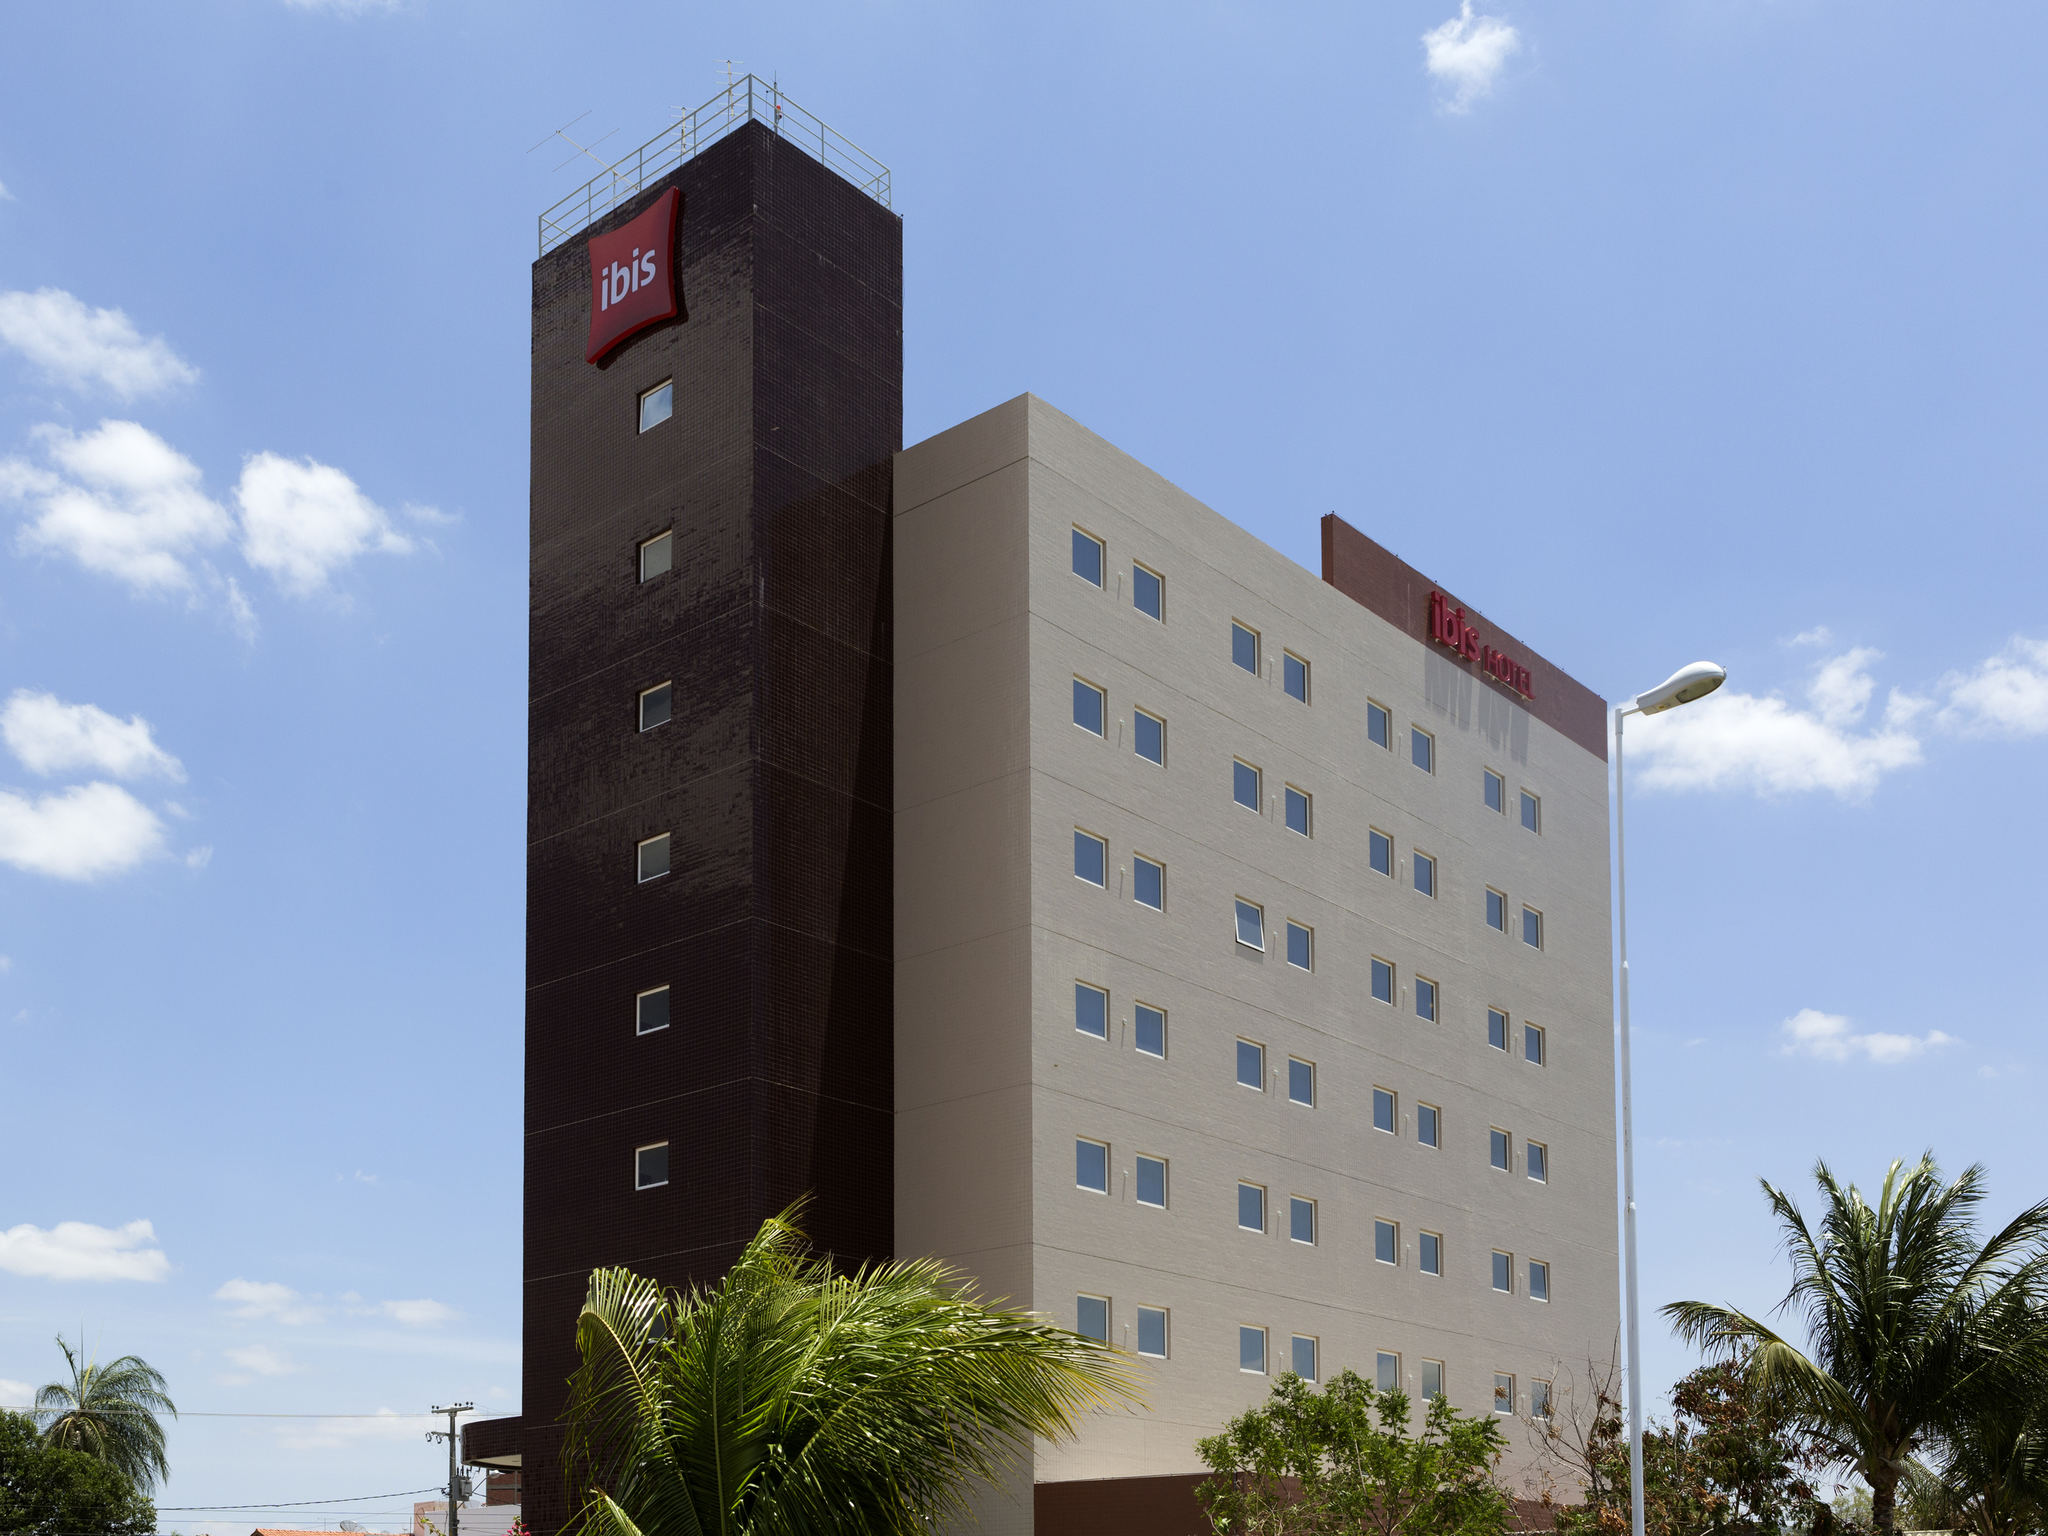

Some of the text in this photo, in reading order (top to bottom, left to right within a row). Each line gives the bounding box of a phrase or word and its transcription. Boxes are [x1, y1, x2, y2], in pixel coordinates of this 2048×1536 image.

[601, 247, 656, 312] ibis
[1431, 590, 1536, 700] ibis HOTEL
